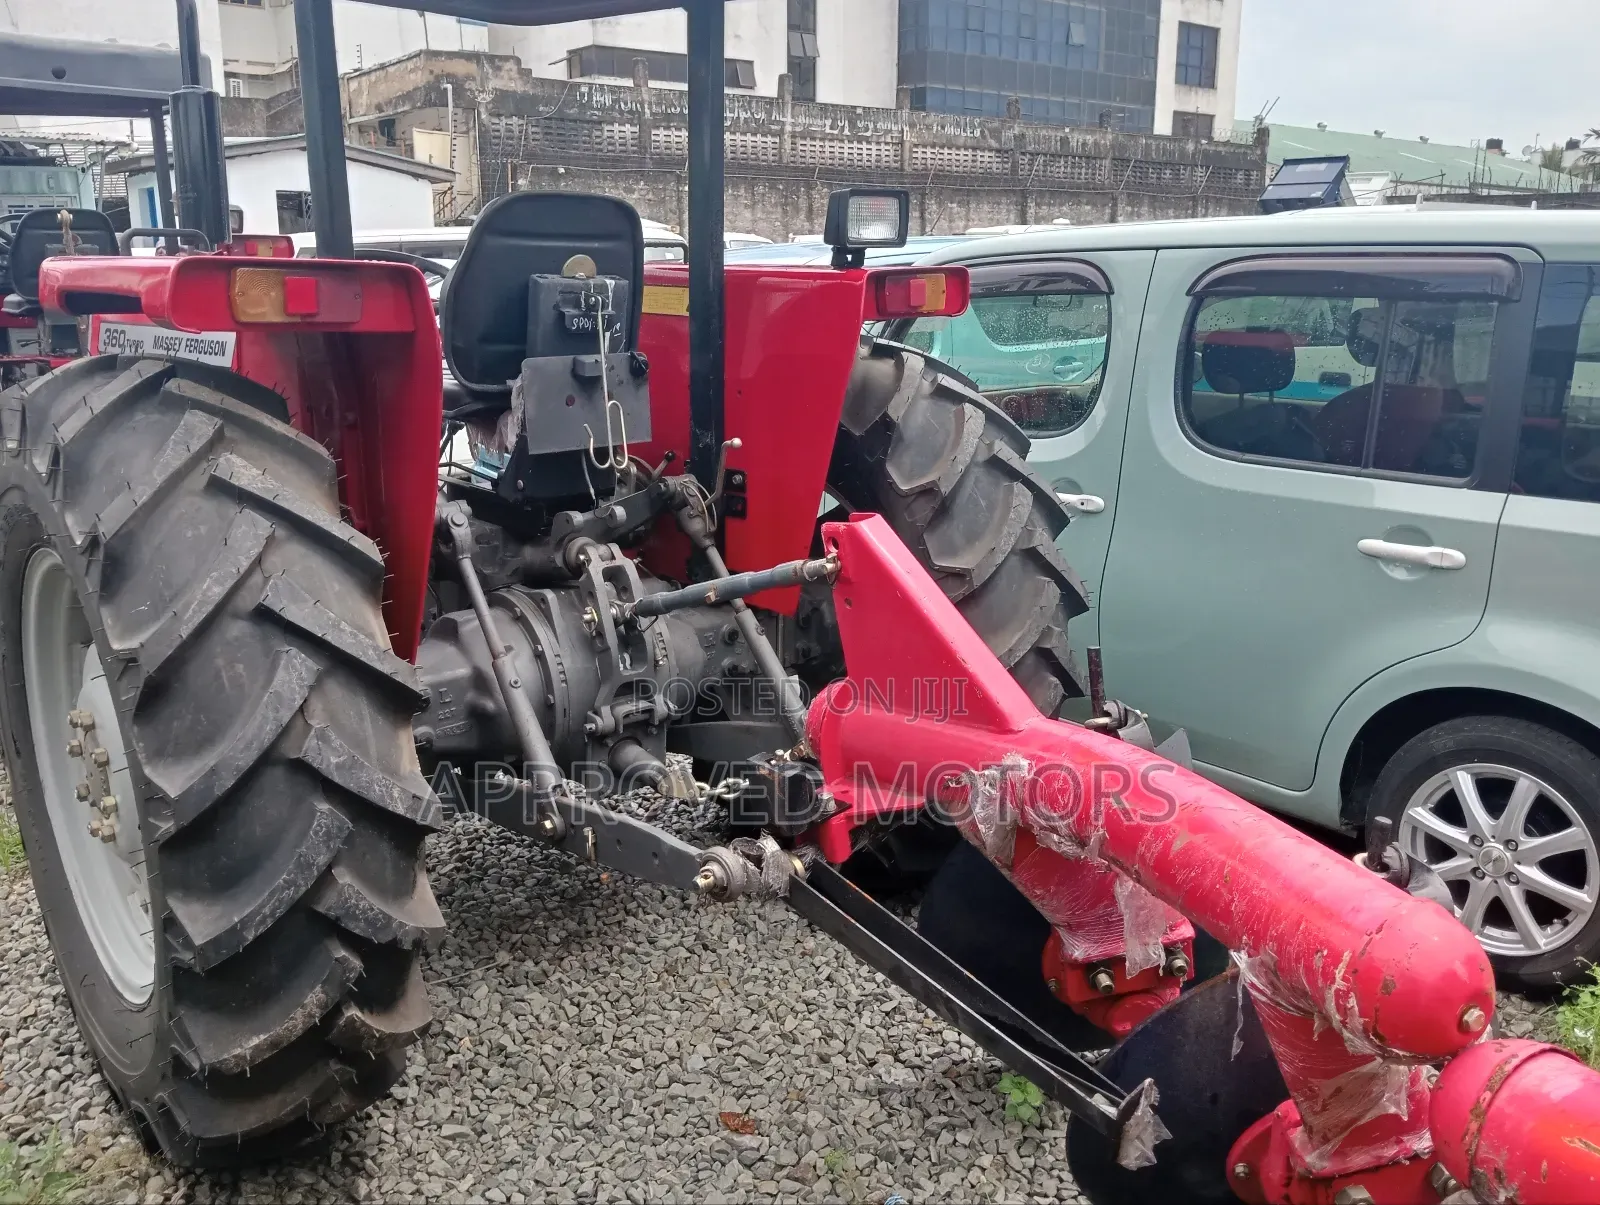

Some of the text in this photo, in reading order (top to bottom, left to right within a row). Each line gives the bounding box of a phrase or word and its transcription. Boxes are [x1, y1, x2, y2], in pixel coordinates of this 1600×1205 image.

[103, 328, 126, 348] 360
[152, 335, 227, 357] MASSEY FERGUSON
